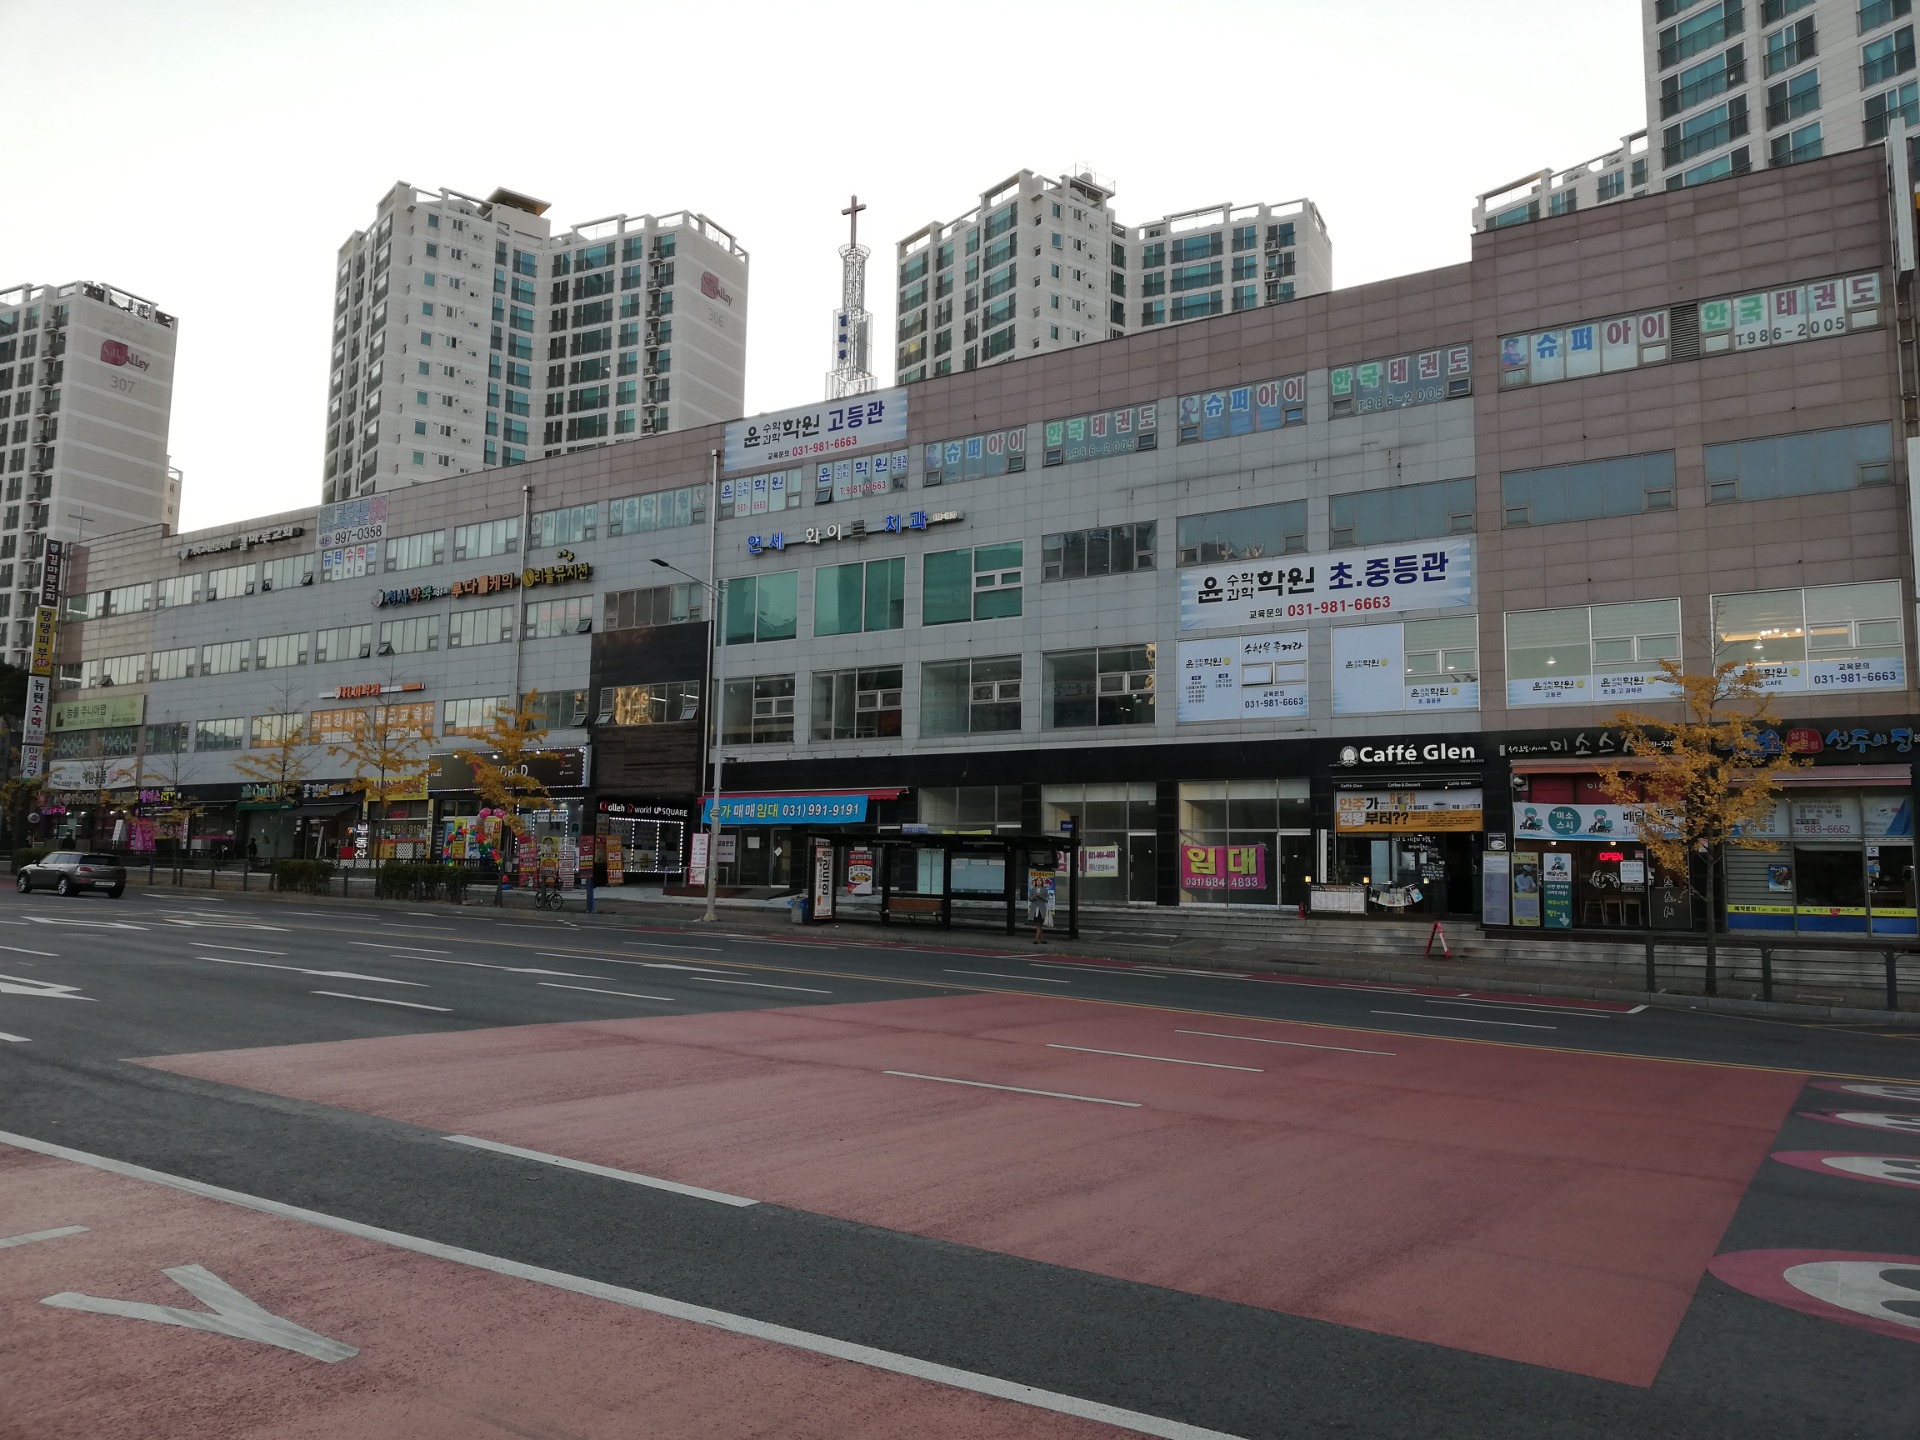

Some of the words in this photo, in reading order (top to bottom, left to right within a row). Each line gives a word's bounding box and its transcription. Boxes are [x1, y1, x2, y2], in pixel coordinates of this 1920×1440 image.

[1704, 276, 1876, 329] 한국태권도
[707, 307, 724, 327] 306
[1536, 314, 1665, 358] 슈퍼아이
[1736, 317, 1845, 347] T.986-2005
[1332, 347, 1470, 395] 한국태권도
[110, 375, 135, 393] 307
[1204, 376, 1304, 417] 슈퍼아이
[1358, 386, 1444, 411] T.986-2005
[783, 414, 819, 438] 학원
[827, 400, 885, 432] 고등관
[1046, 405, 1156, 446] 한국태권도
[792, 436, 857, 457] 031-981-6663
[944, 428, 1025, 463] 슈퍼아이
[855, 457, 888, 475] 학원
[754, 476, 784, 493] 학원
[334, 525, 382, 544] 997-0358
[748, 532, 784, 553] 연세
[885, 510, 928, 533] 치과
[324, 547, 365, 566] 뉴턴수학
[534, 562, 589, 583] 리틀뮤지션
[1198, 576, 1223, 603] 윤
[1227, 572, 1254, 586] 수학
[1257, 567, 1315, 594] 학원
[1329, 551, 1449, 590] 초.중등관
[1227, 586, 1254, 601] 과학
[1249, 607, 1283, 619] 교육문의
[1287, 595, 1391, 617] 031-981-6663
[1204, 657, 1221, 667] 학원
[1363, 659, 1379, 667] 학원
[1839, 662, 1870, 671] 교육문의
[1554, 680, 1574, 689] 학원
[1623, 676, 1644, 685] 학원
[1814, 671, 1896, 684] 031-981-6663
[1430, 687, 1449, 696] 학원
[1245, 698, 1304, 708] 031-981-6663
[1360, 743, 1417, 763] Caffé
[1423, 743, 1475, 760] Glen
[608, 803, 625, 812] olleh
[634, 806, 652, 814] world
[662, 807, 688, 817] SQUARE
[782, 803, 858, 818] 031)991-9191
[1805, 824, 1850, 834] 983-6662
[355, 823, 369, 859] 부동산
[1187, 847, 1257, 875] 임대
[1600, 852, 1623, 861] OPEN
